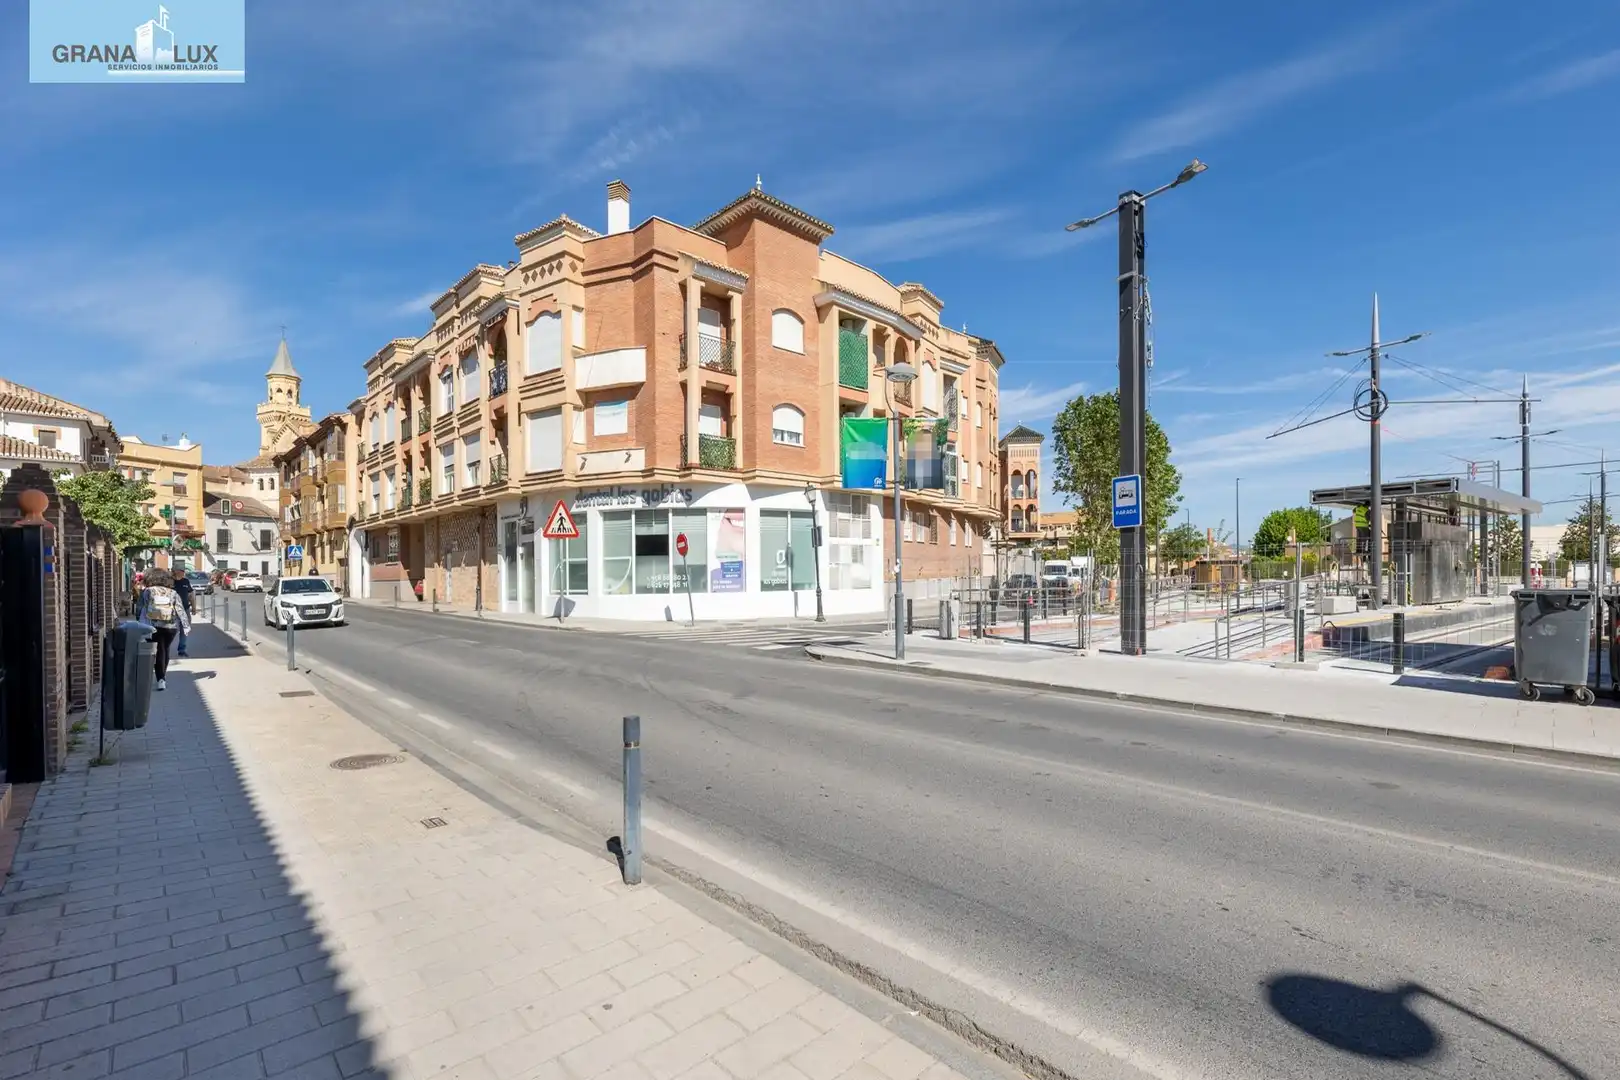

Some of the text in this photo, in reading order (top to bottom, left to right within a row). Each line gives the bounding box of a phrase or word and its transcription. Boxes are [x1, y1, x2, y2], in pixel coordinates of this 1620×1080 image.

[575, 483, 693, 508] dental las gabias
